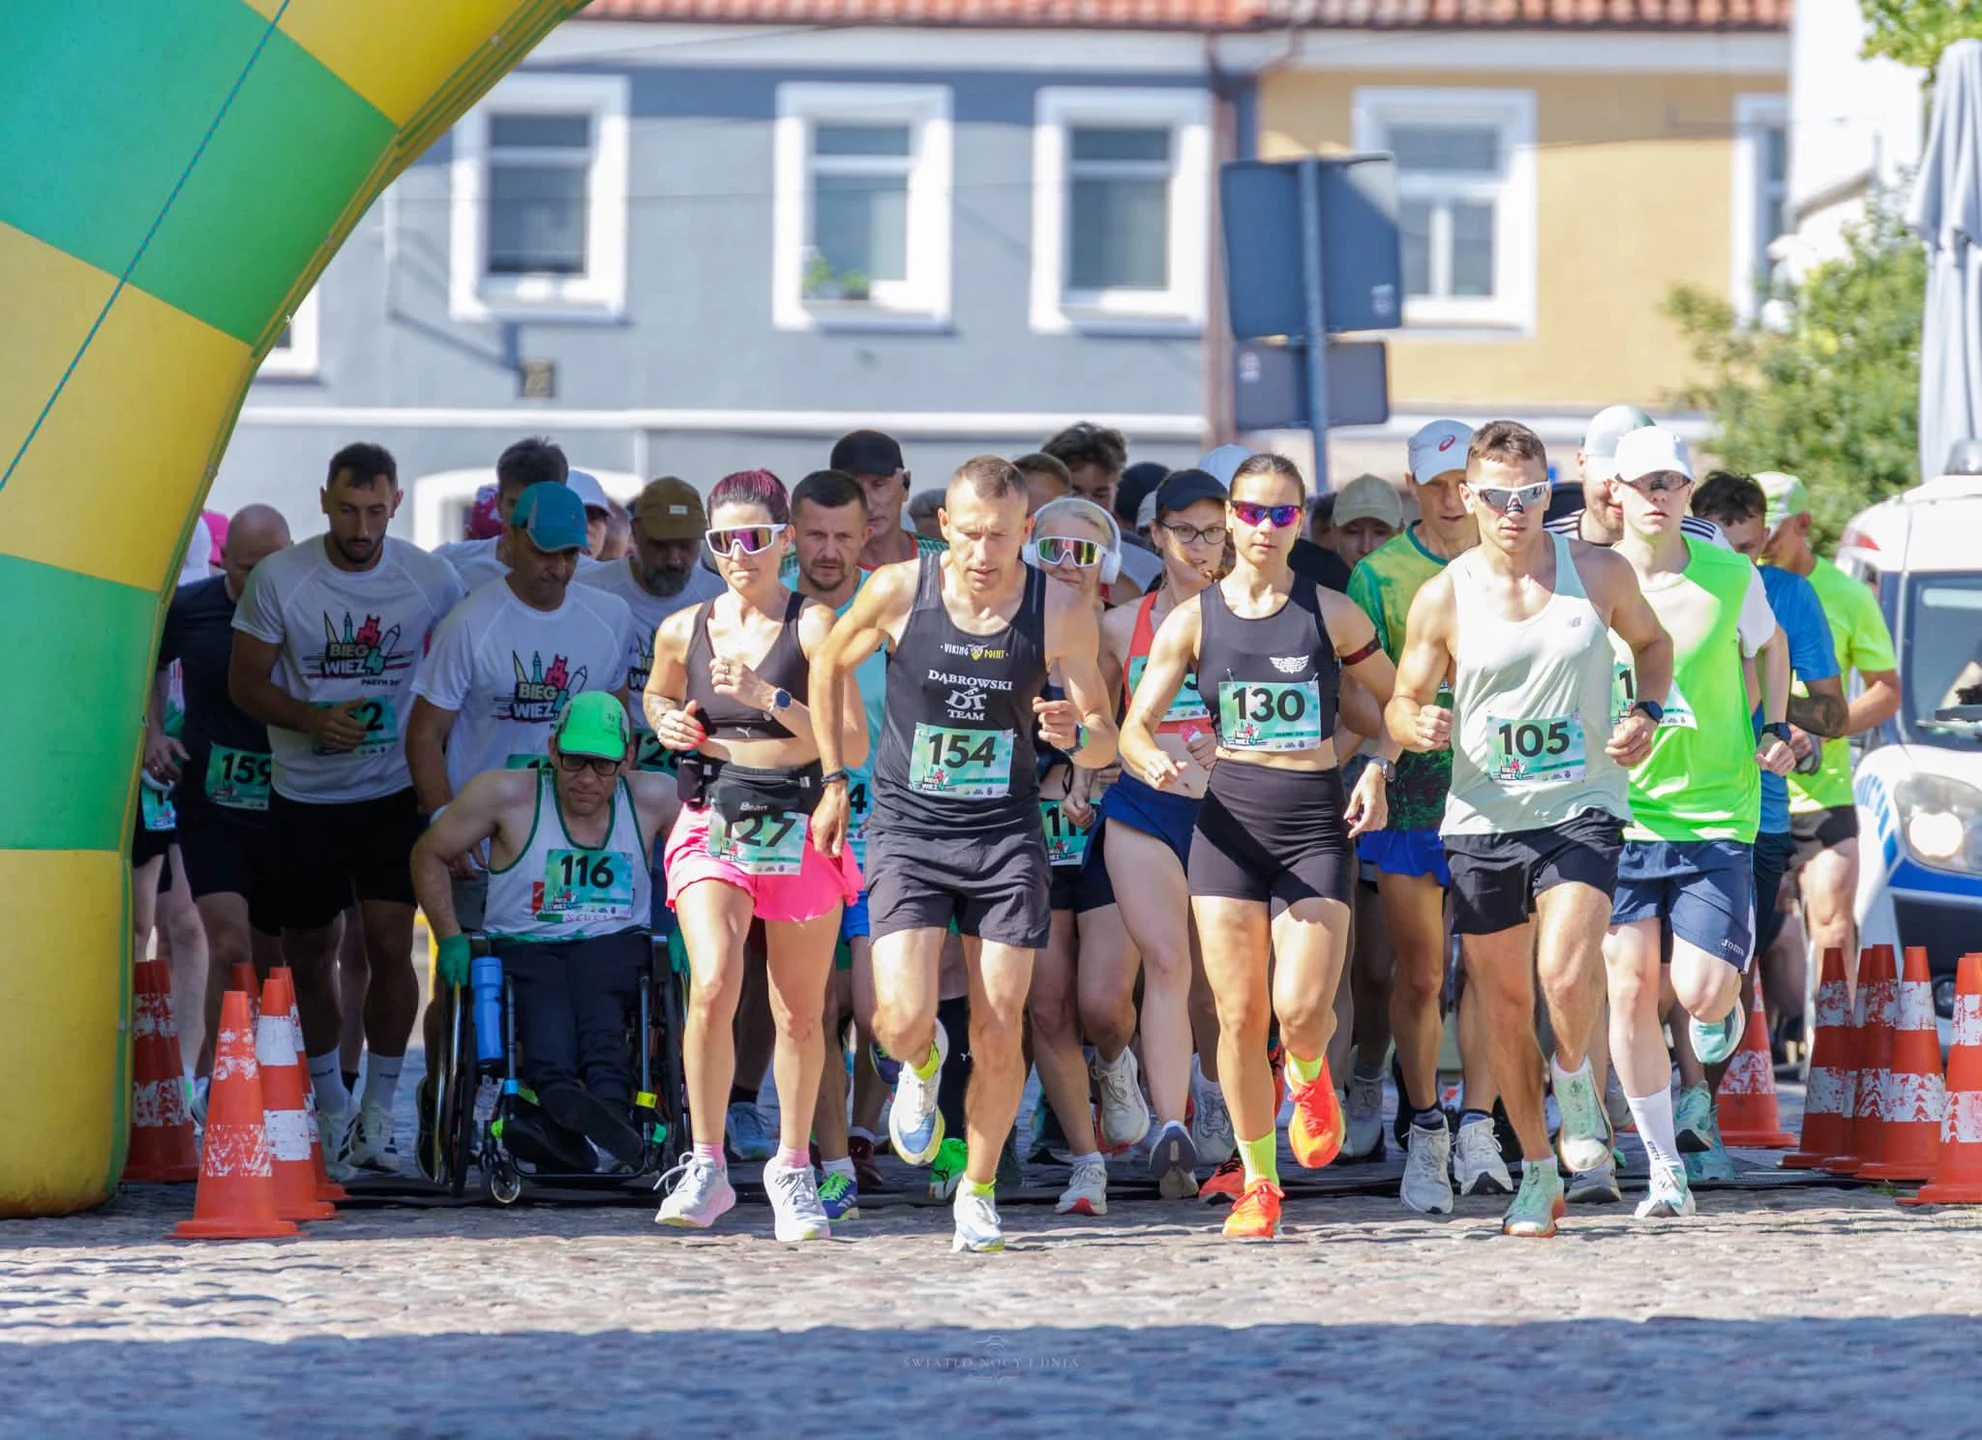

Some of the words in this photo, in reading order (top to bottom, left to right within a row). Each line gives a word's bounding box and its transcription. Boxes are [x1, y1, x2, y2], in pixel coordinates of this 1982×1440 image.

[329, 643, 369, 657] BIEG
[944, 643, 969, 657] VIKING
[984, 649, 1005, 659] POINT
[518, 682, 558, 700] BIEG
[927, 669, 1013, 691] DĄBROWSKI
[947, 709, 985, 721] TEAM
[1233, 687, 1305, 722] 130
[928, 732, 996, 769] 154
[1498, 721, 1570, 757] 105
[222, 752, 272, 786] 159
[1046, 805, 1089, 837] 11
[560, 854, 614, 888] 116
